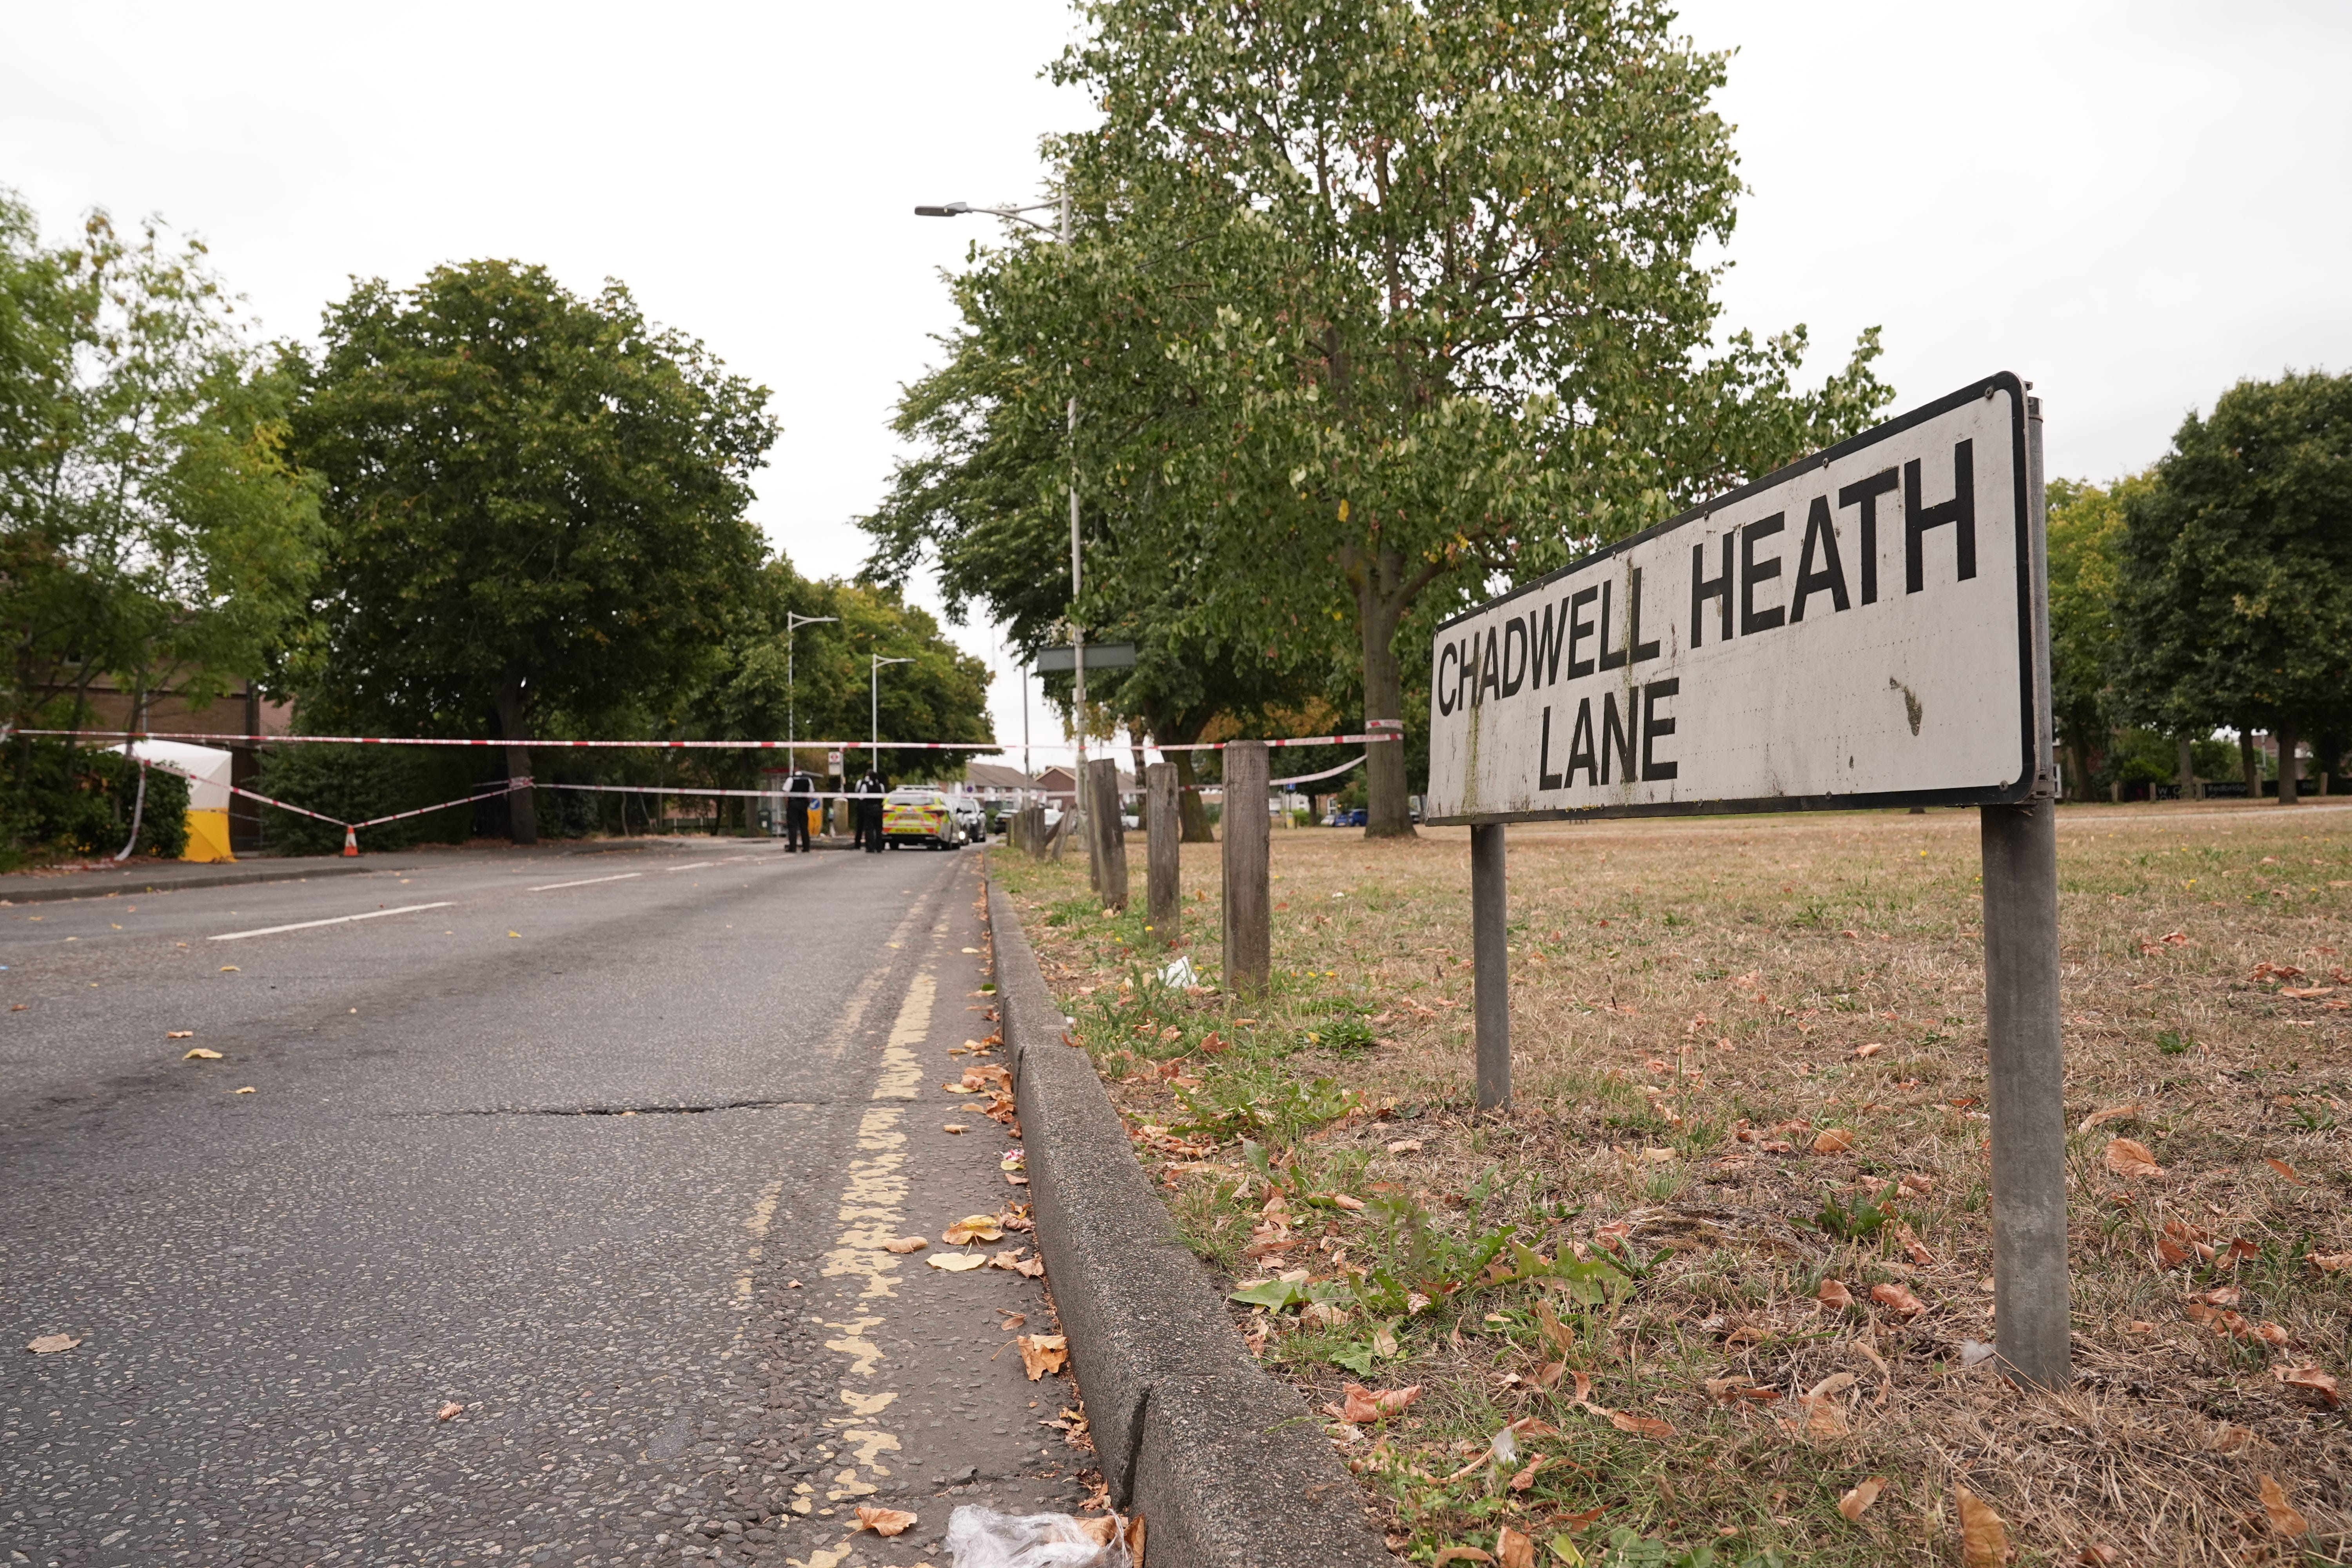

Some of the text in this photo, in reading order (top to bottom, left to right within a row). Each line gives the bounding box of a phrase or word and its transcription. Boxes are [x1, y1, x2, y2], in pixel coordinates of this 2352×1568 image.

[1438, 438, 1976, 717] CHADWELL HEATH
[1539, 677, 1679, 791] LANE
